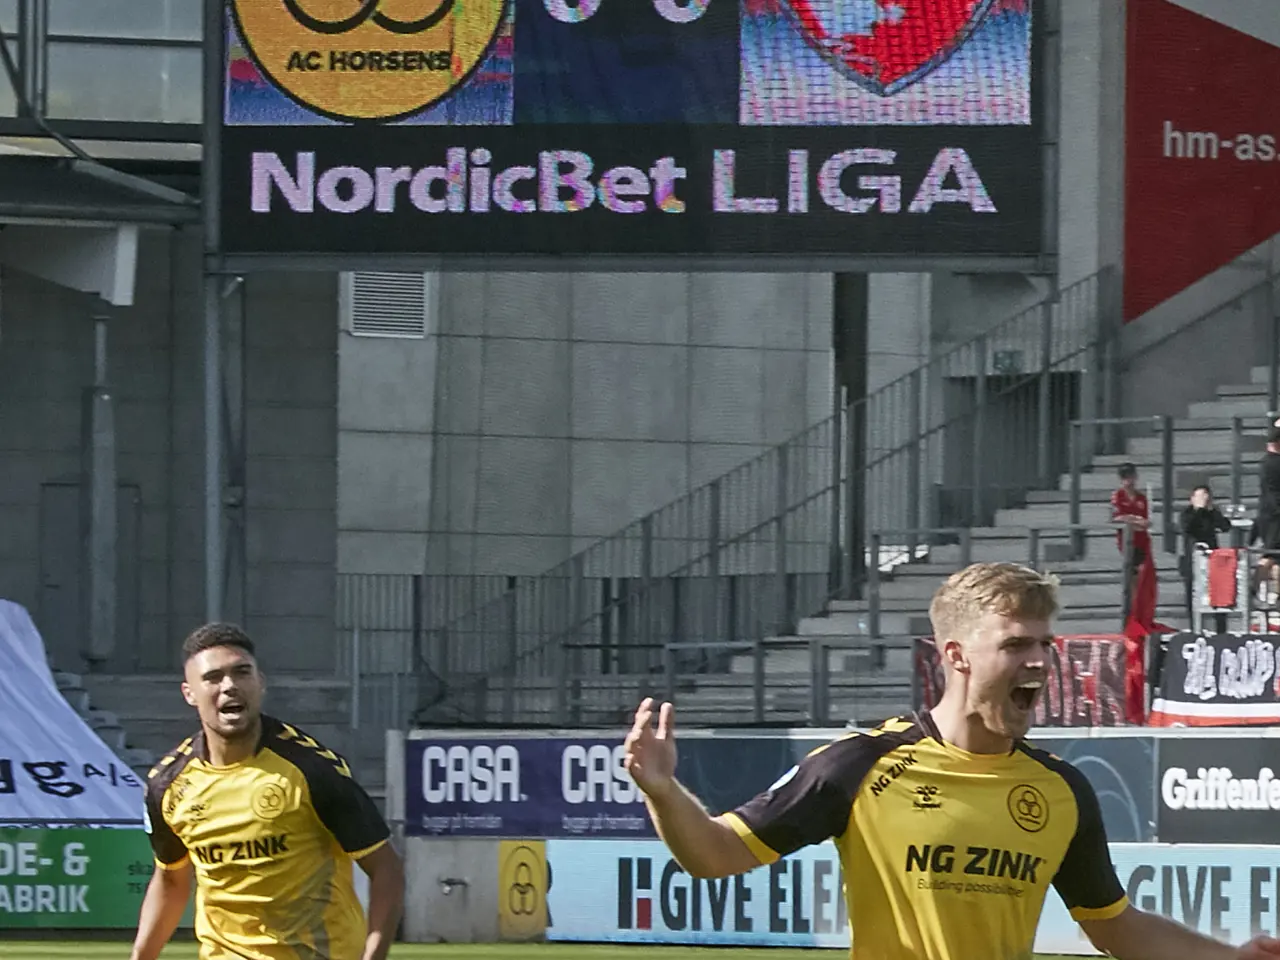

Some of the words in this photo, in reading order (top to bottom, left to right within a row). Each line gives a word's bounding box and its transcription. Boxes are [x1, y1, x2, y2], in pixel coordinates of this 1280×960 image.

[287, 51, 322, 71] AC
[329, 51, 452, 71] HORSENS
[251, 147, 686, 213] NordicBet
[712, 147, 998, 213] LIGA
[422, 746, 520, 803] CASA
[562, 745, 646, 803] CAS
[870, 776, 891, 797] NG
[886, 753, 919, 781] ZINK
[63, 842, 91, 876] &
[195, 846, 223, 864] NG
[231, 834, 290, 860] ZINK
[905, 845, 956, 874] NG
[964, 846, 1042, 884] ZINK
[660, 858, 753, 932] GIVE
[769, 858, 850, 935] ELE
